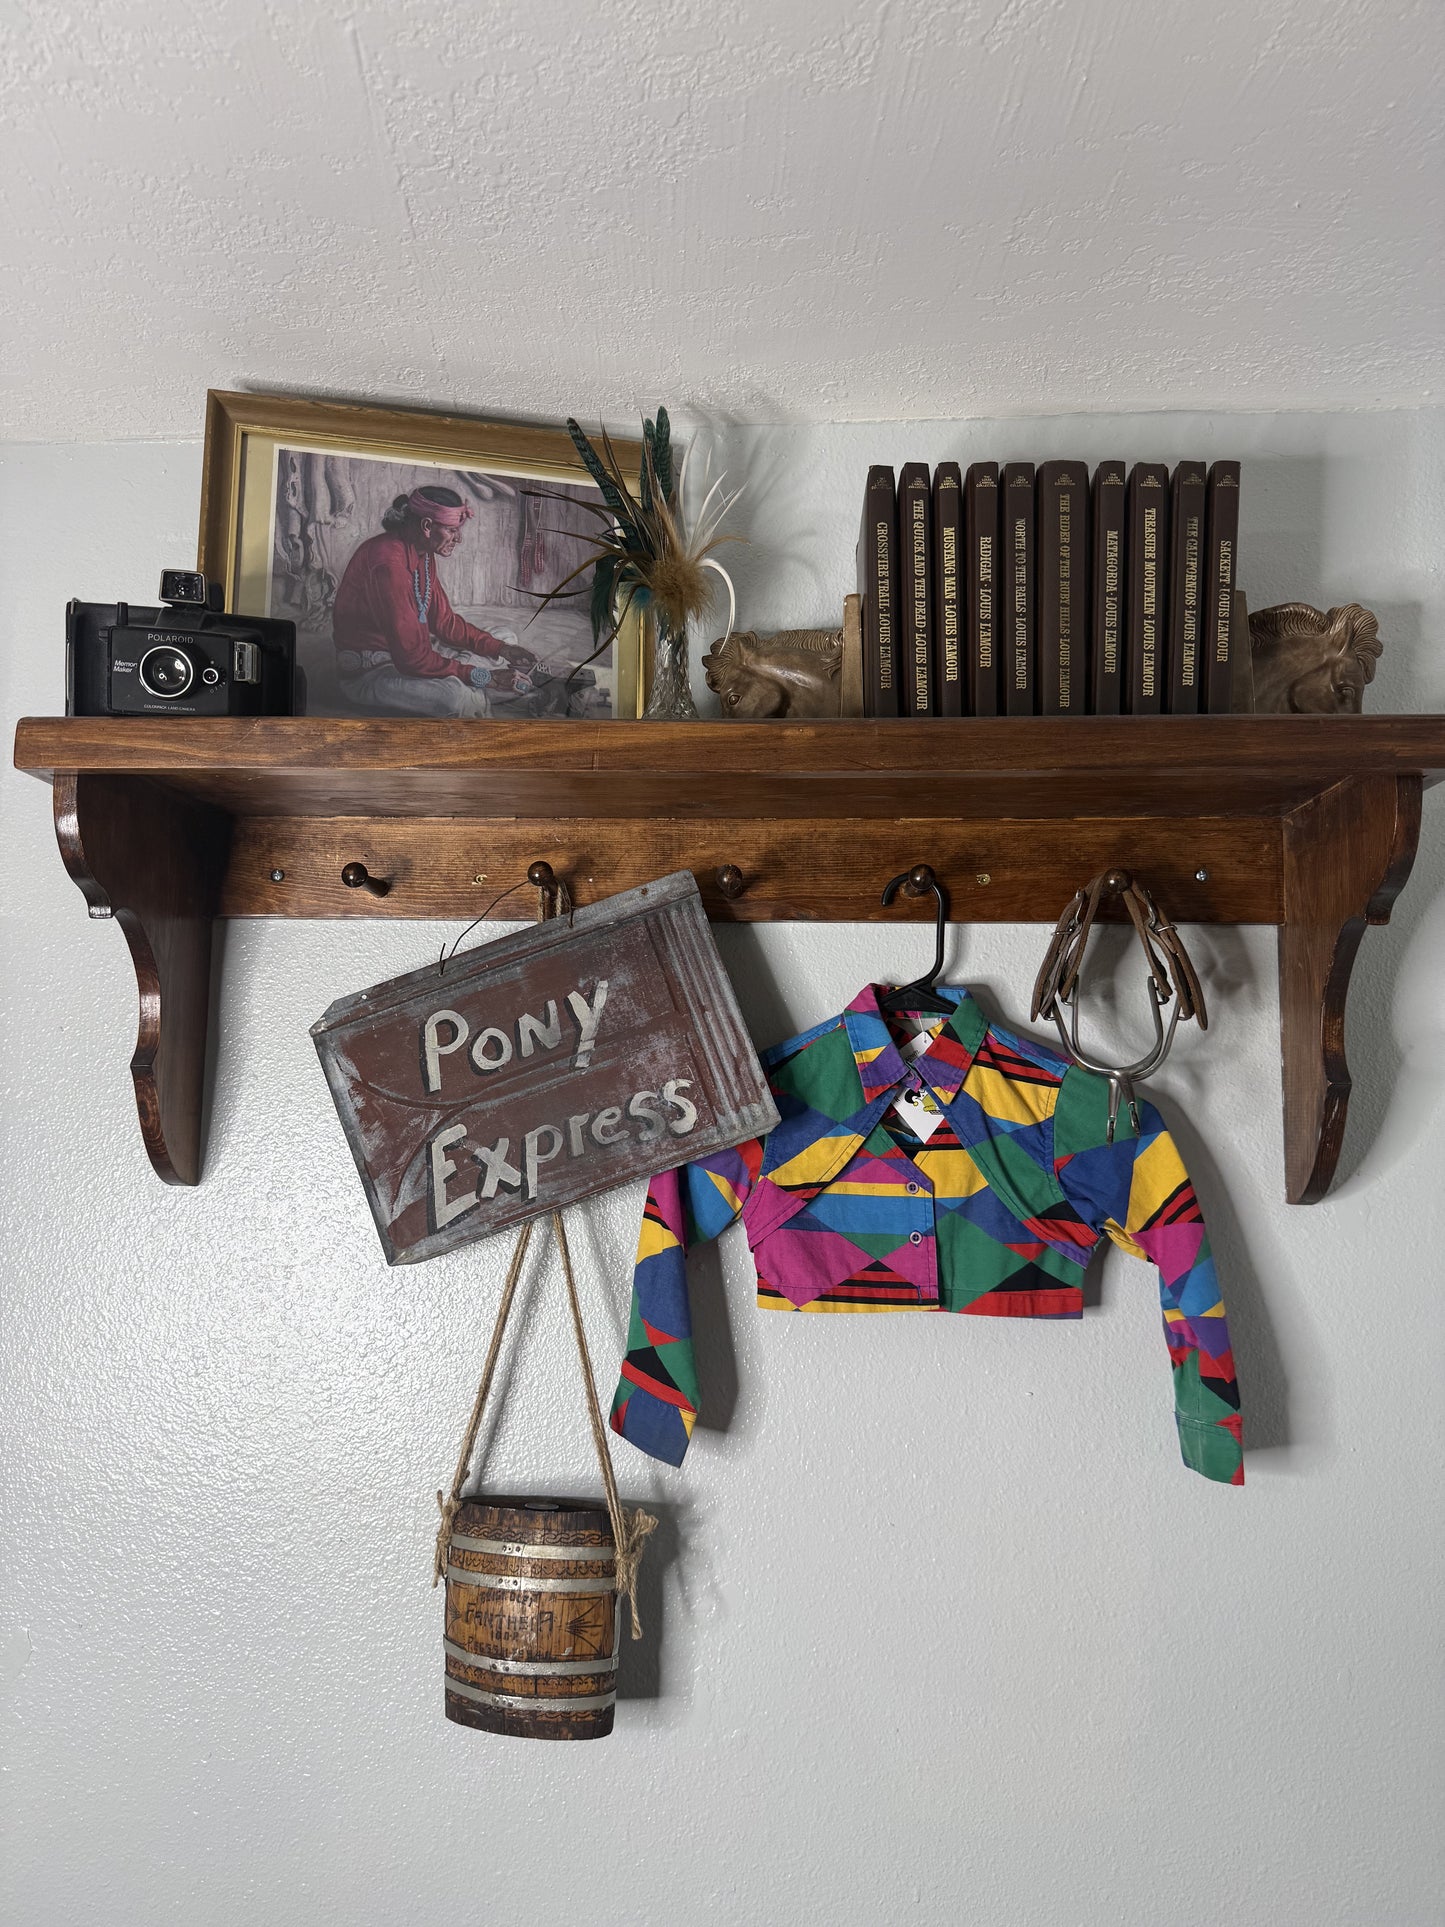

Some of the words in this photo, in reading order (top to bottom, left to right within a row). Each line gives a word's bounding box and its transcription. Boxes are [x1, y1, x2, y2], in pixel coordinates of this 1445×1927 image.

[913, 500, 924, 519] THE
[1060, 494, 1070, 513] THE
[913, 522, 925, 553] QUICK
[1015, 518, 1025, 550] NORTH
[1059, 515, 1070, 543] RIDER
[1144, 508, 1156, 559] TREASURE
[1186, 517, 1198, 537] THE
[877, 522, 888, 577] CROSSFIRE
[914, 555, 925, 575] AND
[944, 527, 955, 574] MUSTANG
[980, 537, 991, 582] RADIGAN
[1059, 546, 1070, 559] OF
[1106, 530, 1118, 592] MATAGORDA
[1219, 541, 1231, 583] SACKETT
[1016, 565, 1025, 583] THE
[1059, 559, 1070, 578] THE
[1185, 538, 1198, 606] CALIFORNIOS
[878, 580, 889, 609] TRAIL
[914, 578, 926, 598] THE
[944, 577, 956, 599] MAN
[1016, 586, 1025, 613] RAILS
[1059, 580, 1070, 604] RUBY
[1143, 562, 1155, 614] MOUNTAIN
[915, 601, 926, 628] DEAD
[980, 589, 991, 619] LOUIS
[1105, 597, 1117, 628] LOUIS
[879, 614, 890, 643] LOUIS
[945, 605, 956, 635] LOUIS
[1016, 618, 1026, 646] LOUIS
[1059, 606, 1070, 634] HILLS
[1143, 619, 1155, 650] LOUIS
[1184, 611, 1196, 640] LOUIS
[147, 633, 194, 644] POLAROID
[916, 633, 927, 664] LOUIS
[980, 623, 991, 667] L'AMOUR
[1059, 638, 1070, 666] LOUIS
[1104, 630, 1116, 673] L'AMOUR
[1217, 620, 1230, 662] L'AMOUR
[879, 646, 891, 689] L'AMOUR
[946, 638, 957, 681] L'AMOUR
[1016, 649, 1026, 689] L'AMOUR
[1142, 653, 1155, 696] L'AMOUR
[1182, 643, 1195, 686] L'AMOUR
[916, 667, 927, 710] L'AMOUR
[1059, 668, 1070, 708] L'AMOUR
